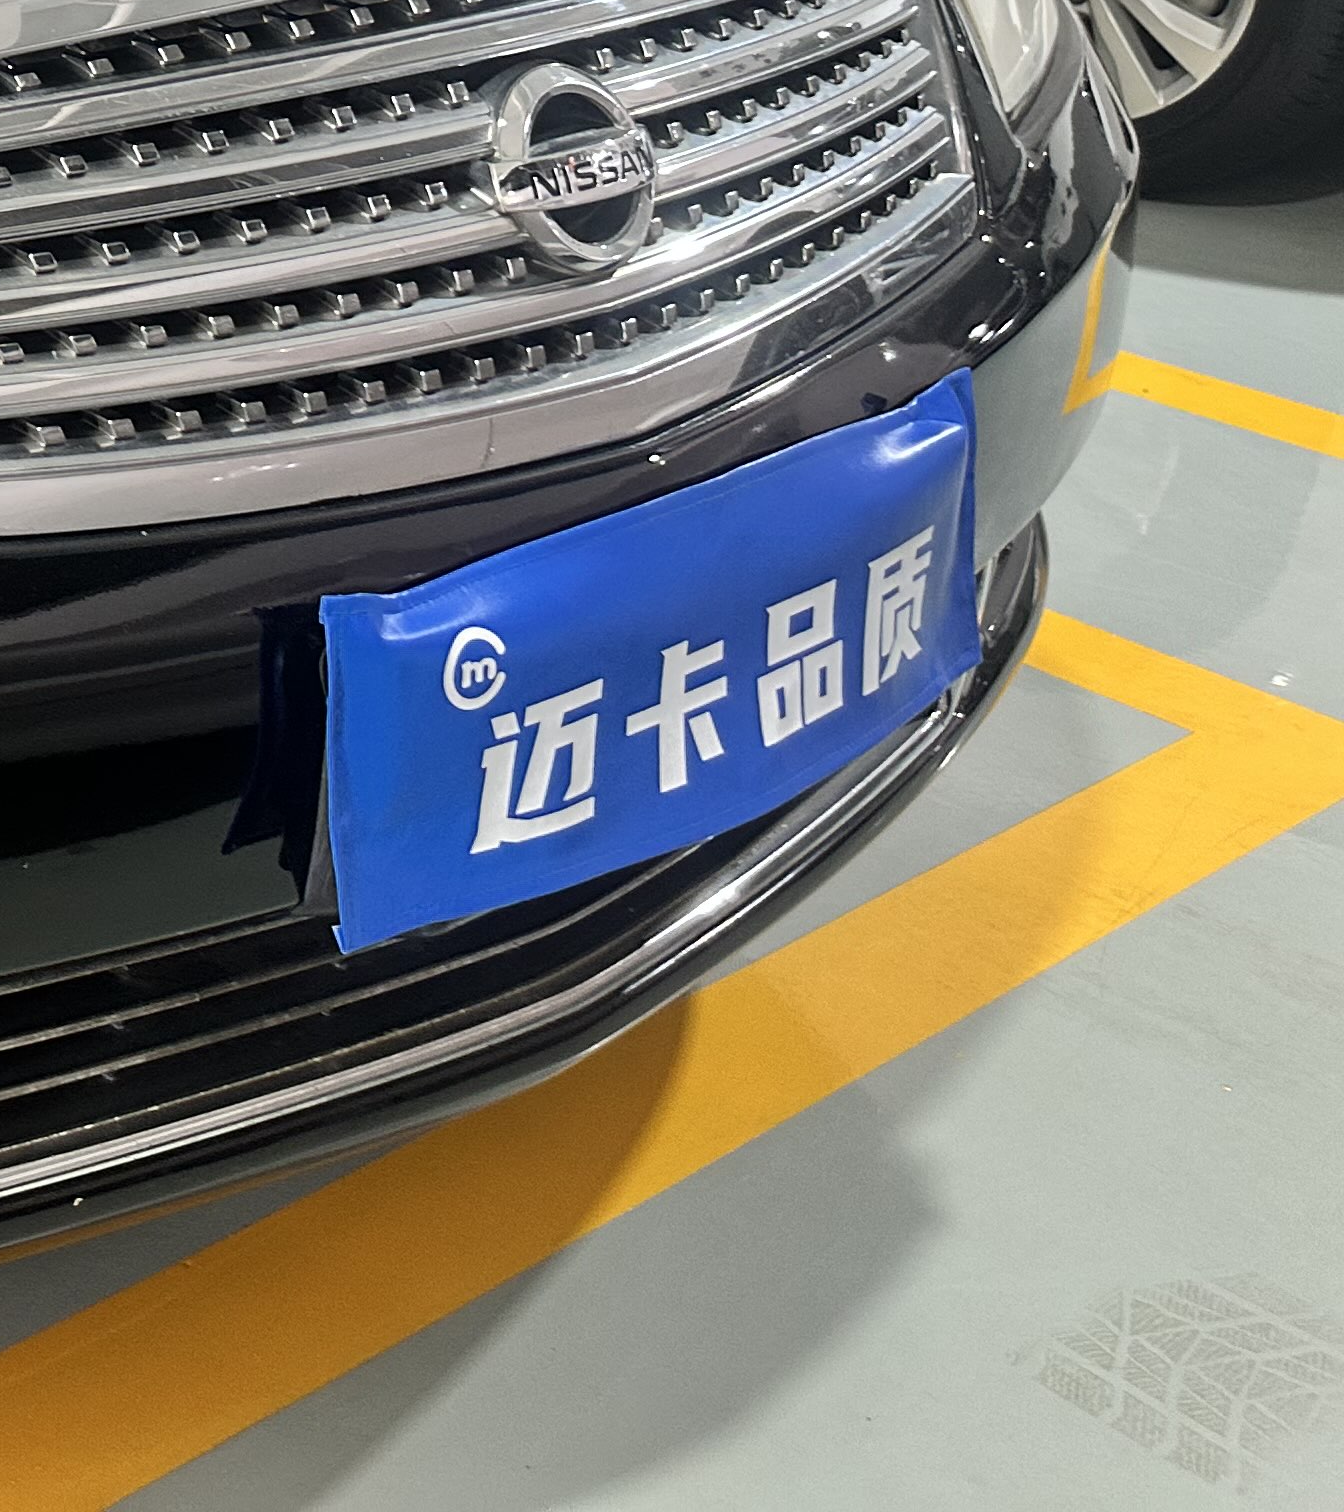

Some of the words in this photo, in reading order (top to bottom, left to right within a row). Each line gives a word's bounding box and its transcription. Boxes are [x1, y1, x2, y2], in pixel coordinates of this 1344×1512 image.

[531, 146, 654, 199] NISSAN
[470, 524, 935, 856] 迈卡品质
